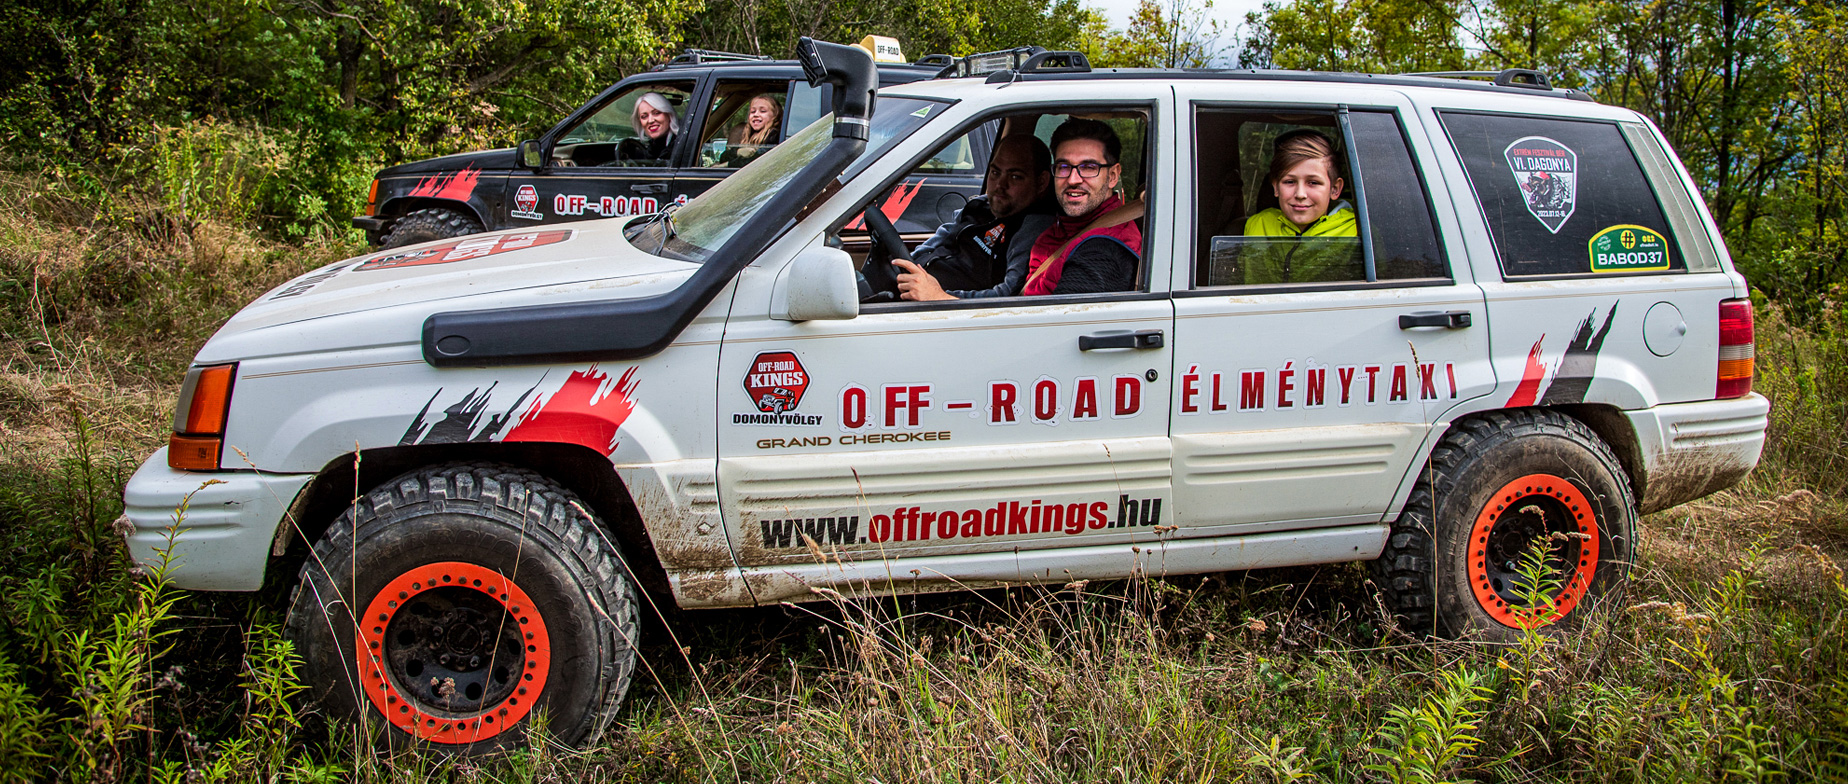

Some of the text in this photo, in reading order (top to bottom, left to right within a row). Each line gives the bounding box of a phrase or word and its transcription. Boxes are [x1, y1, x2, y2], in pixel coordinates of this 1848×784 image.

[878, 45, 899, 55] OFF-ROAD
[1513, 157, 1571, 171] VI. DAGONYA
[557, 196, 657, 214] OFF-ROAD
[1597, 251, 1663, 265] BABOD37
[758, 361, 794, 372] OFF-ROAD
[750, 372, 803, 388] KINGS
[1181, 361, 1457, 412] ÉLMÉNYTAXI
[733, 413, 822, 425] DOMONYVÖLGY
[757, 431, 951, 449] GRAND CHEROKEE
[761, 494, 1162, 549] www.offroadkings.hu
